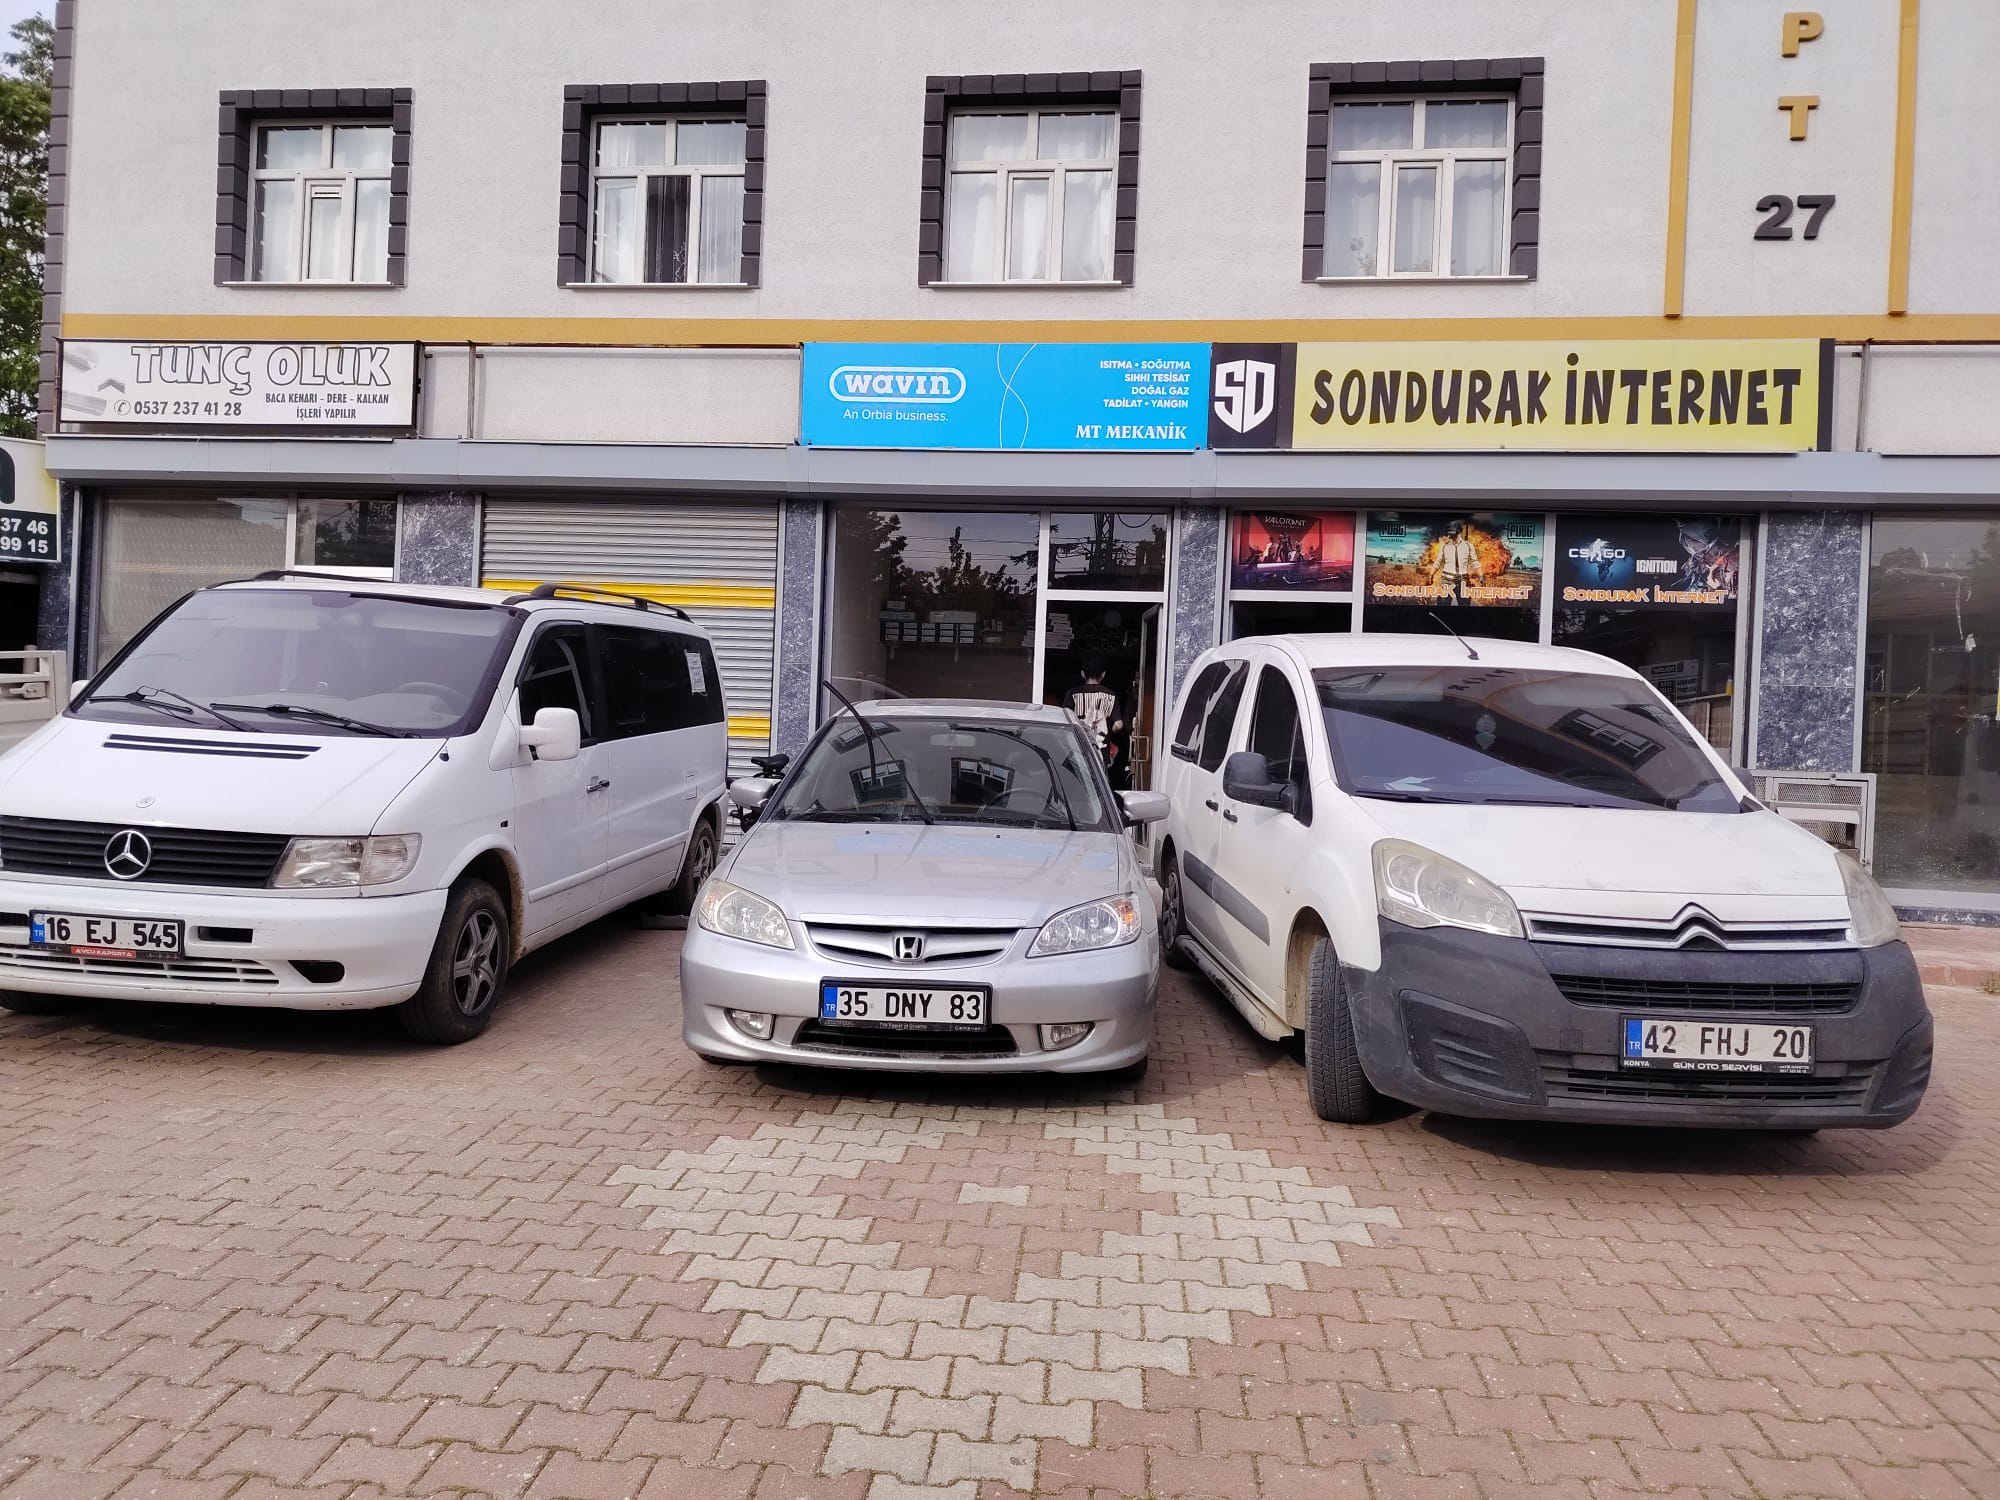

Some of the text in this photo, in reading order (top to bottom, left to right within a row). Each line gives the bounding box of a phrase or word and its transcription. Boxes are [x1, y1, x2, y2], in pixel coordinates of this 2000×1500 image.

[1753, 194, 1836, 241] 27
[131, 345, 391, 396] TUNÇ OLUK
[1100, 358, 1191, 369] ISITMA SOĞUTMA
[844, 374, 951, 395] wavin
[1151, 371, 1191, 383] TESİSAT
[1131, 384, 1190, 395] DOĞAL GAZ
[1310, 352, 1802, 427] SONDURAK İNTERNET
[265, 393, 286, 403] BACA
[288, 393, 318, 404] KENARI
[326, 393, 348, 404] DERE
[356, 393, 390, 404] KALKAN
[1103, 397, 1189, 408] TADİLAT YANGIN
[133, 400, 243, 416] 0537 237 41 28
[296, 406, 357, 421] İŞLERİ YAPILIR
[843, 408, 950, 421] An Orbia business.
[1075, 421, 1187, 439] MT MEKANİK
[26, 519, 48, 535] 46
[1264, 515, 1306, 527] VALORANT
[1509, 524, 1533, 538] PUBG
[27, 538, 48, 554] 15
[1636, 559, 1678, 574] IGNITION
[1563, 586, 1650, 603] SONDURAK
[34, 917, 177, 949] TR 16 EJ 545
[825, 990, 981, 1020] TR 35 DNY 83
[1628, 1025, 1806, 1059] TR 42 FHJ 20
[1623, 1060, 1650, 1068] KONYA
[1672, 1060, 1695, 1070] GÜN
[1721, 1063, 1763, 1072] SERVİSİ
